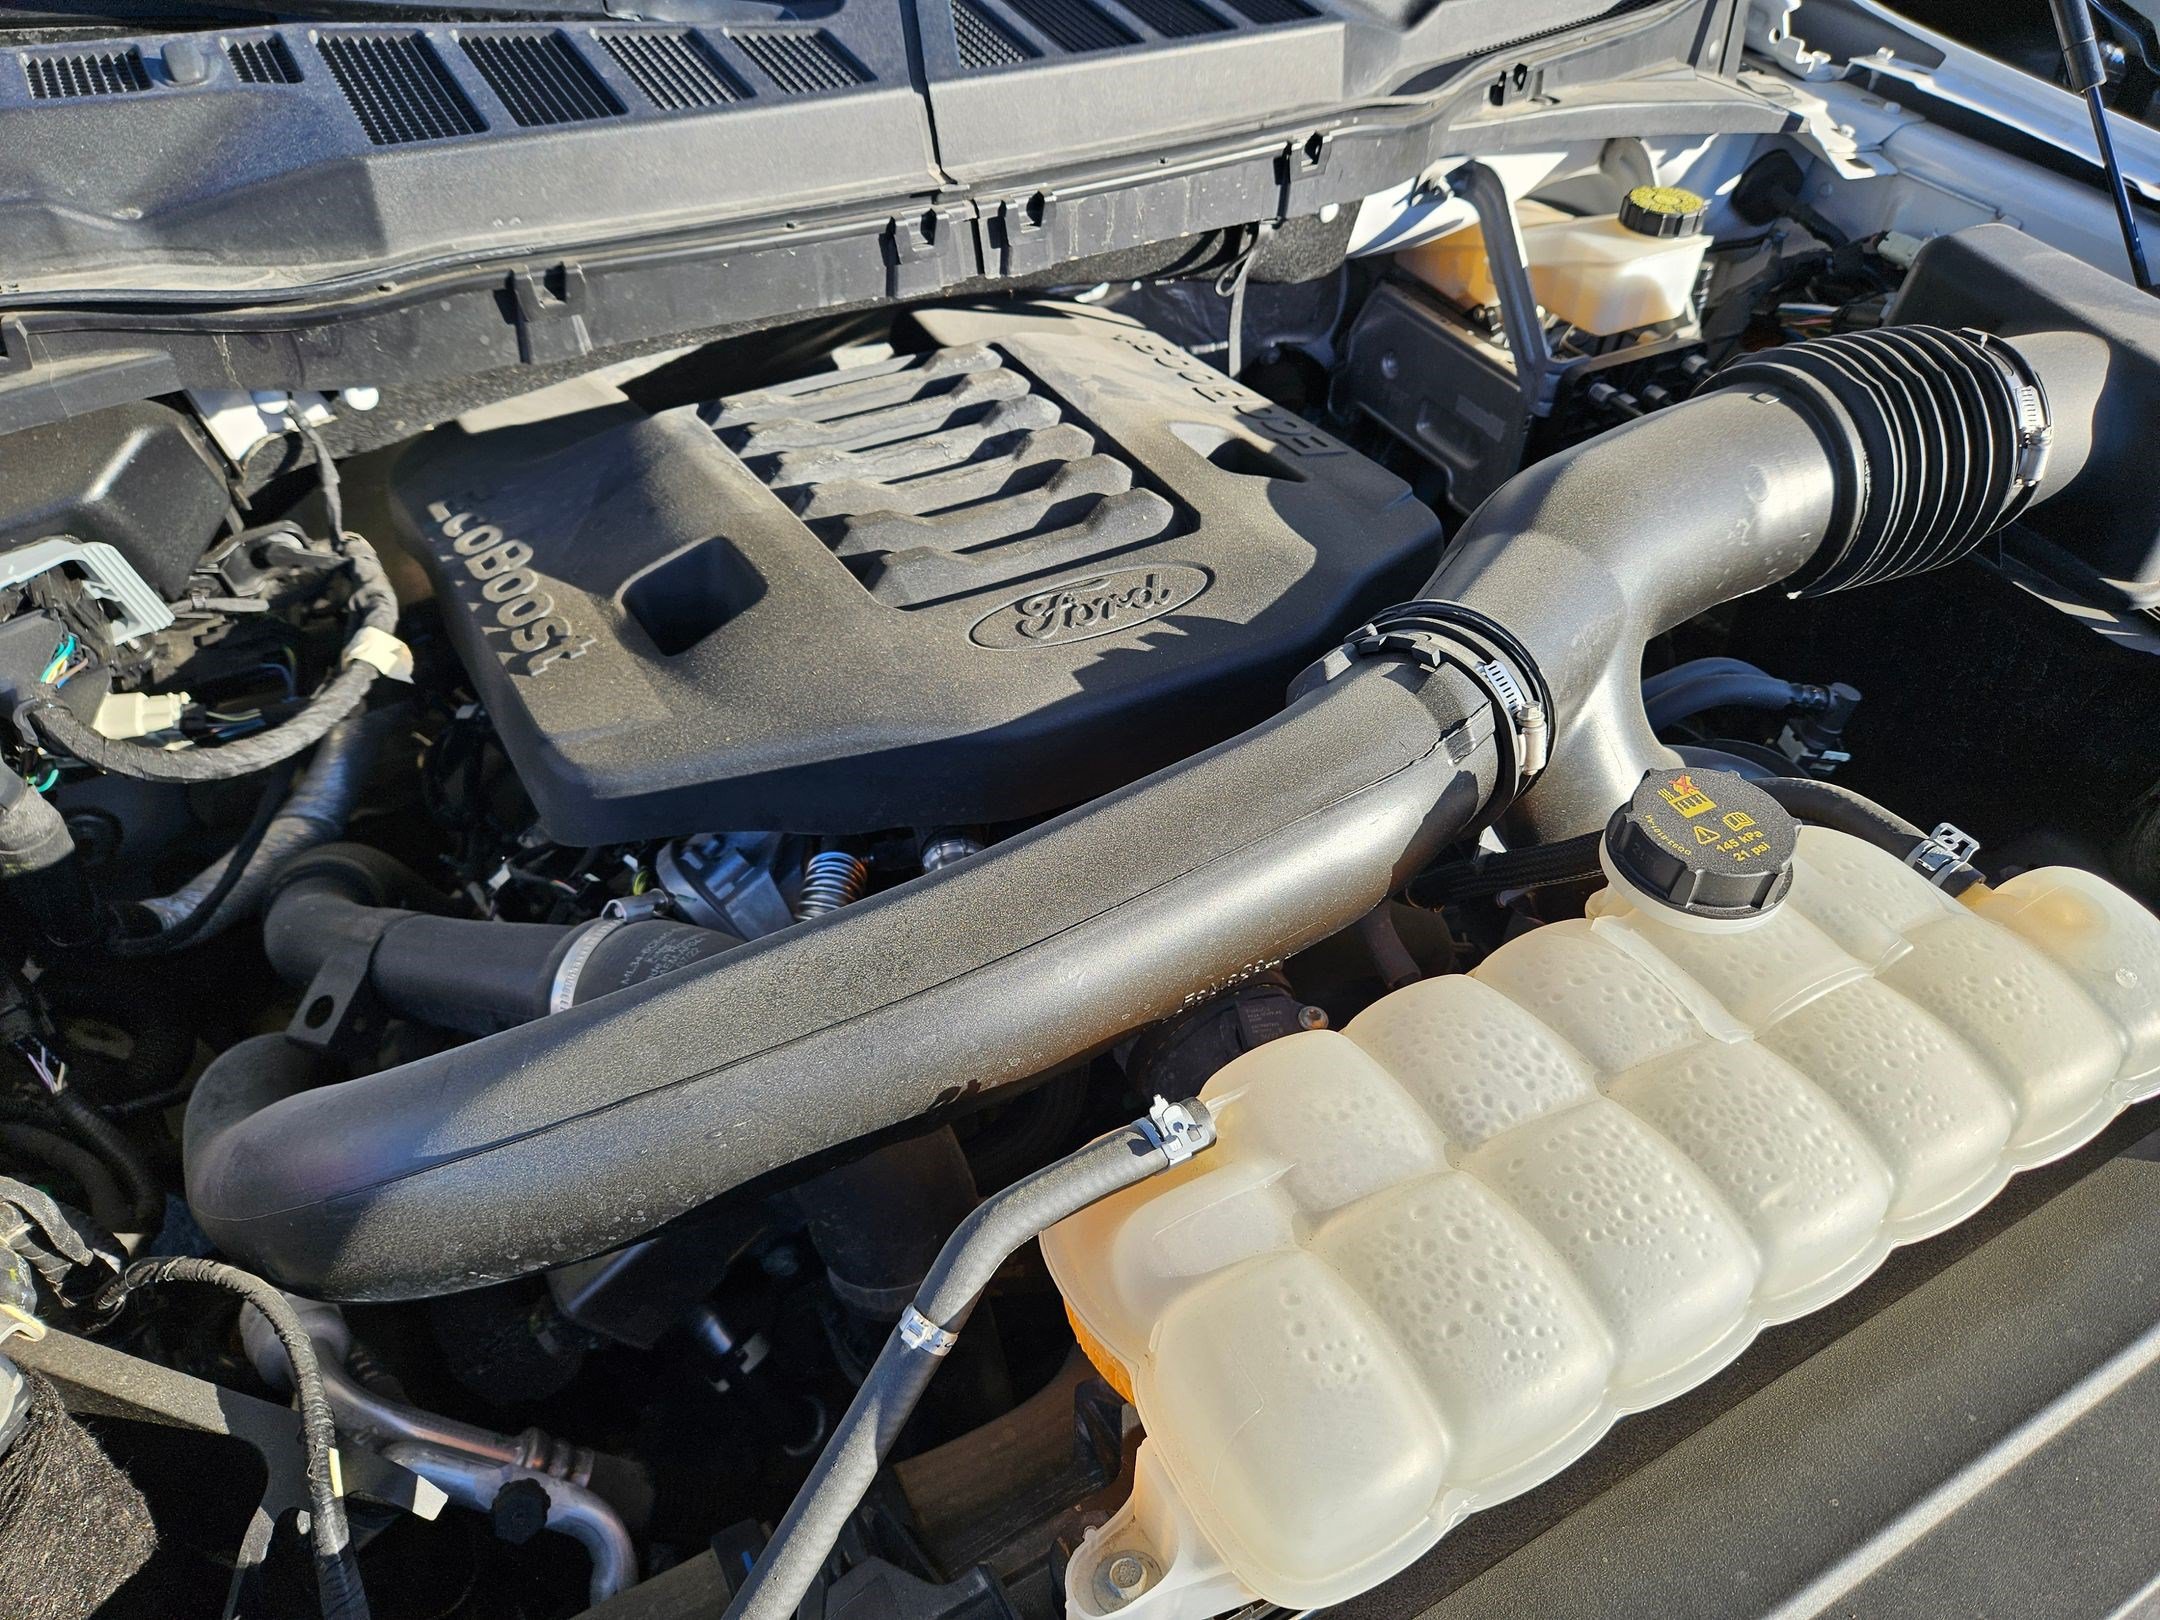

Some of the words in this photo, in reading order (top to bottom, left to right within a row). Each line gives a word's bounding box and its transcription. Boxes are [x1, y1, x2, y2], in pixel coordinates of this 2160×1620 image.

[1015, 573, 1174, 641] Ford
[1716, 839, 1740, 853] 145
[1737, 830, 1765, 844] kPa
[1732, 849, 1751, 862] 21
[1751, 841, 1771, 856] psi
